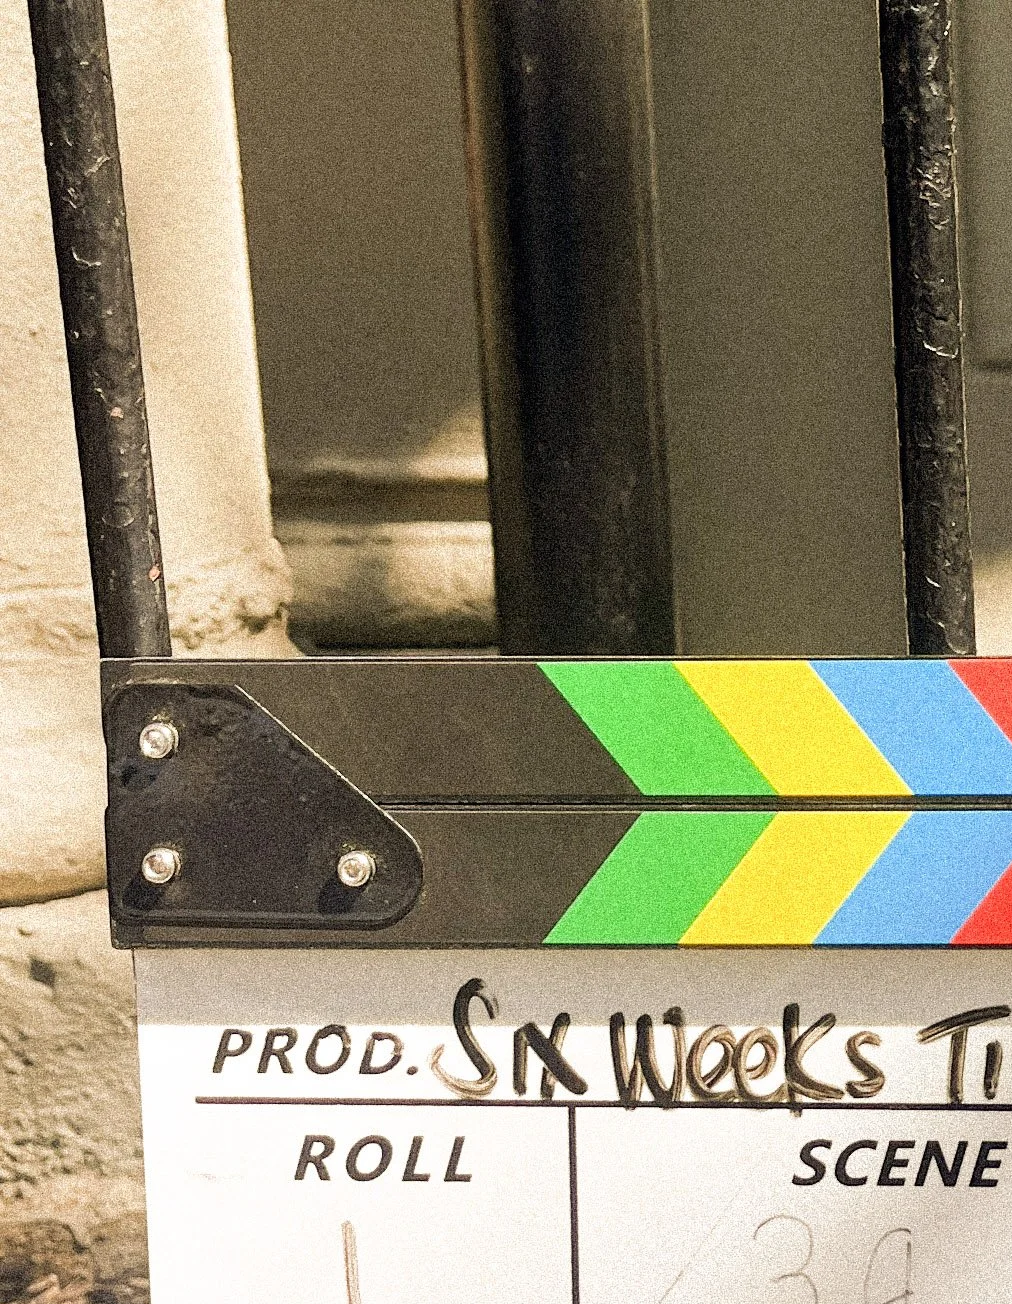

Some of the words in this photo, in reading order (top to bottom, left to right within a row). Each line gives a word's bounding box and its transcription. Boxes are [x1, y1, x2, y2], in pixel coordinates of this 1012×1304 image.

[212, 1022, 420, 1076] PROD.
[609, 1001, 886, 1116] Weeks
[294, 1134, 474, 1183] ROLL
[791, 1139, 1008, 1188] SCENE
